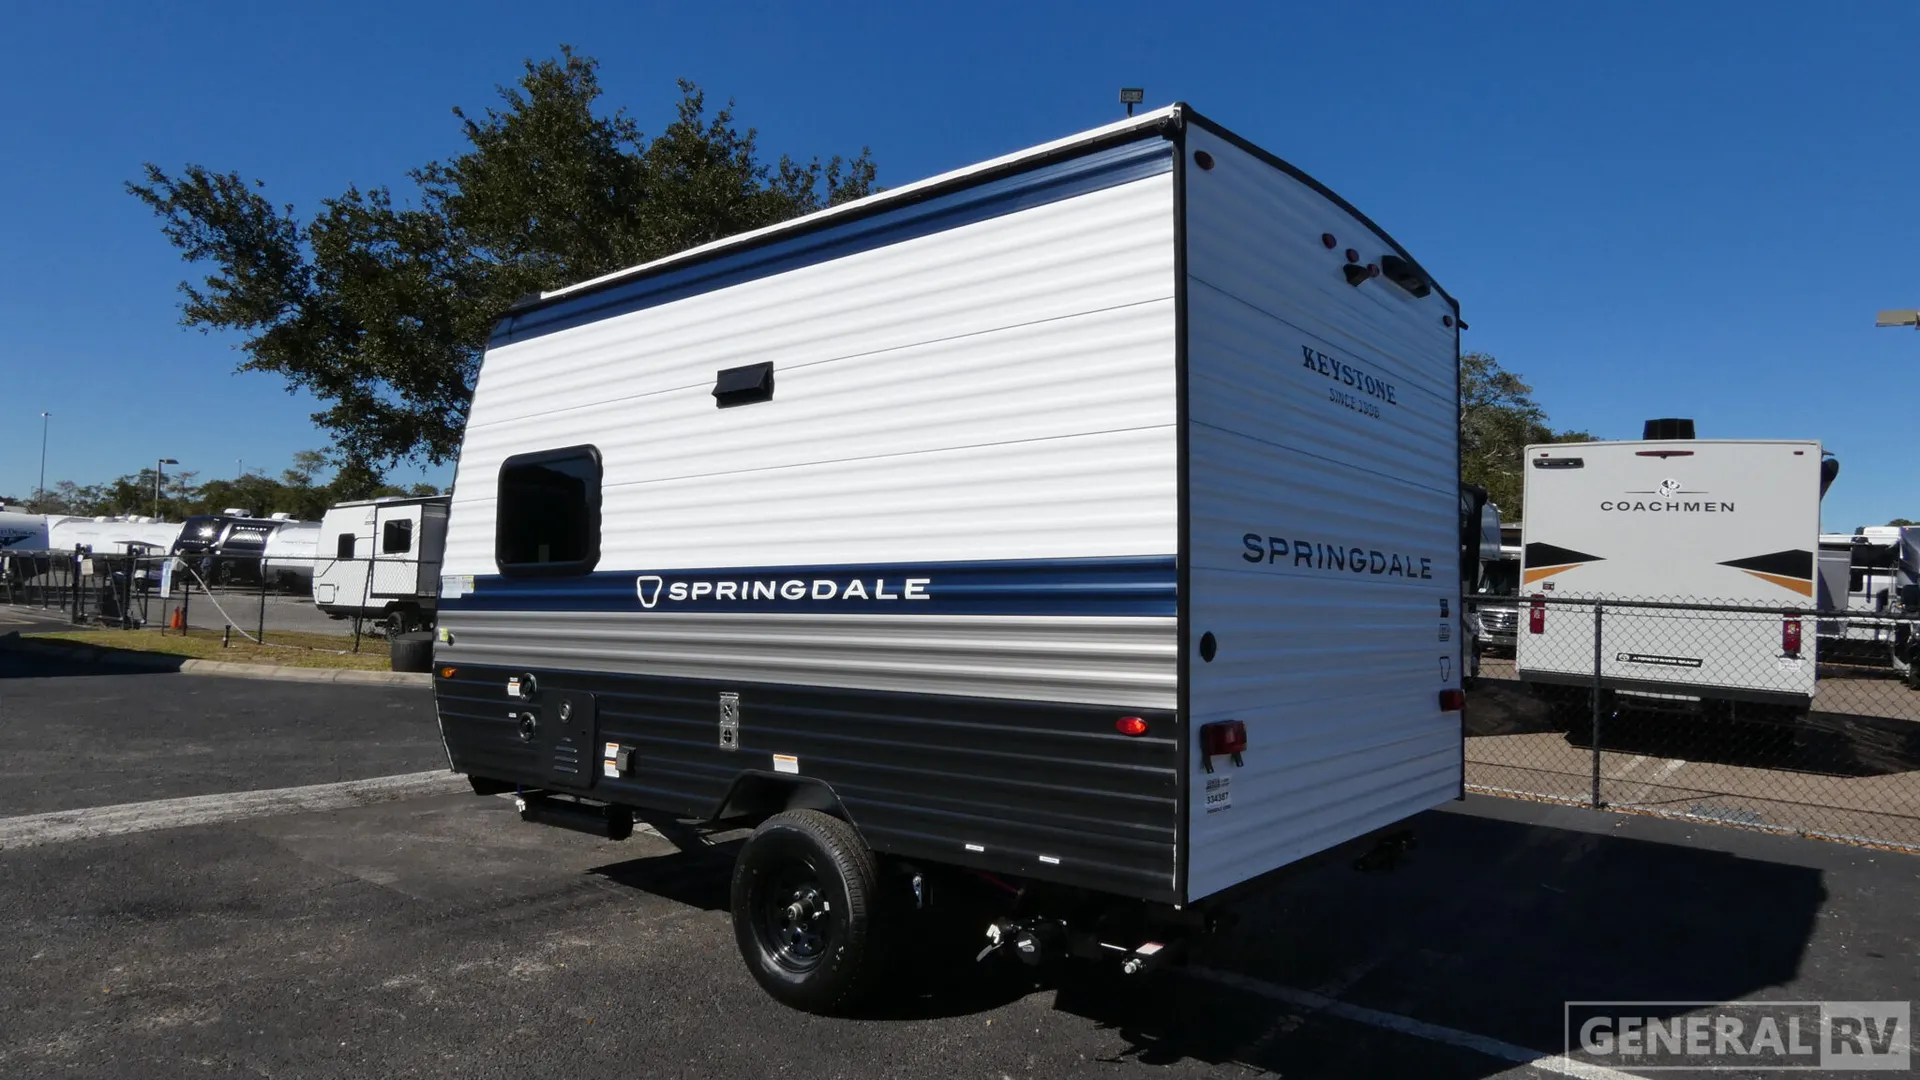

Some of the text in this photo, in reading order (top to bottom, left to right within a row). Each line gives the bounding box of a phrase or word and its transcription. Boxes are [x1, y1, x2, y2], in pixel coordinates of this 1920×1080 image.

[1302, 345, 1397, 405] KEYSTONE
[1329, 388, 1356, 410] SINCE
[1600, 500, 1735, 513] COACHMEN
[1243, 534, 1432, 579] SPRINGDALE
[668, 577, 931, 602] SPRINGDALE
